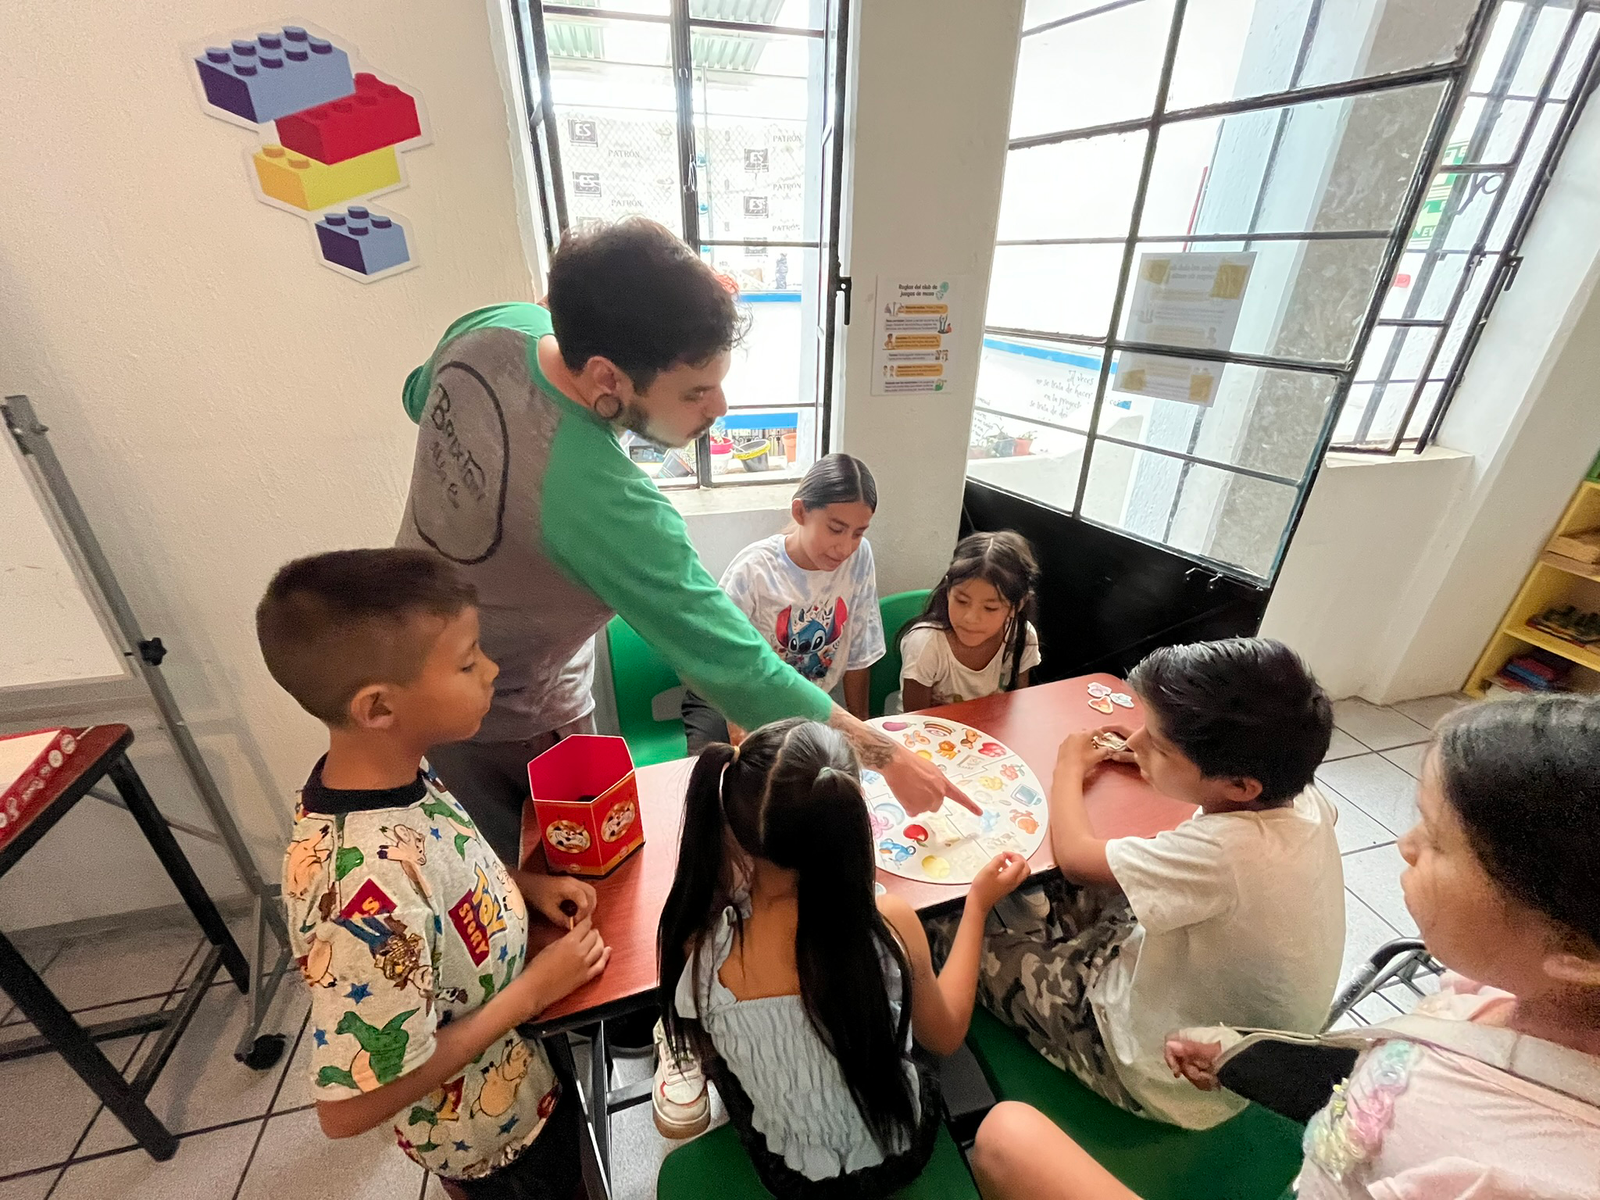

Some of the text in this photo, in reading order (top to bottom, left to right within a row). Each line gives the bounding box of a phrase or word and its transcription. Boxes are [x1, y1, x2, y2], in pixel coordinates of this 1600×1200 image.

[608, 149, 640, 158] PATRÓN
[458, 901, 491, 956] STORY
[472, 861, 508, 941] TOY
